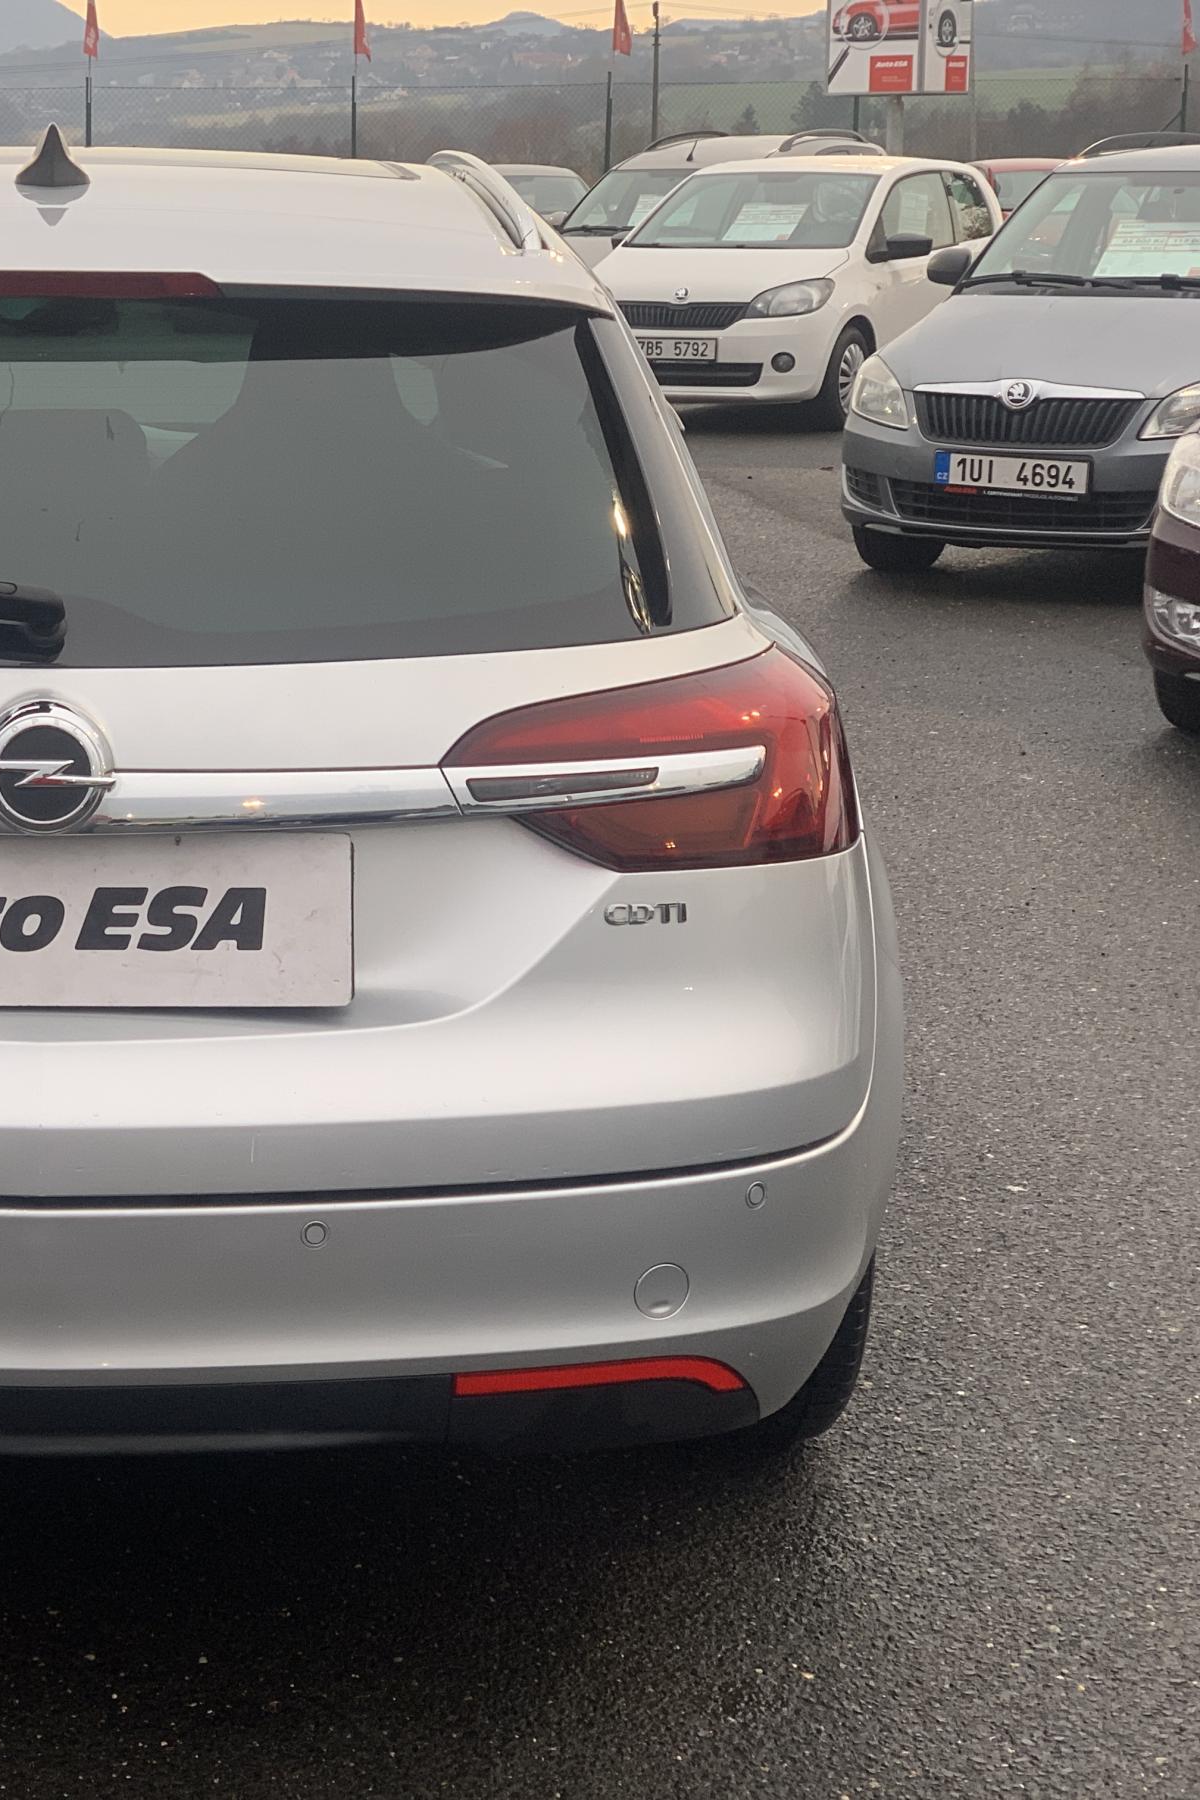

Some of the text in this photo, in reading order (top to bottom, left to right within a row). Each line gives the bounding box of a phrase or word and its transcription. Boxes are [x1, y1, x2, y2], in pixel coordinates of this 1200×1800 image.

[674, 342, 709, 357] 5792
[936, 471, 948, 480] CZ
[1016, 462, 1075, 489] 4694
[74, 885, 268, 951] ESA
[604, 902, 687, 926] CDTI
